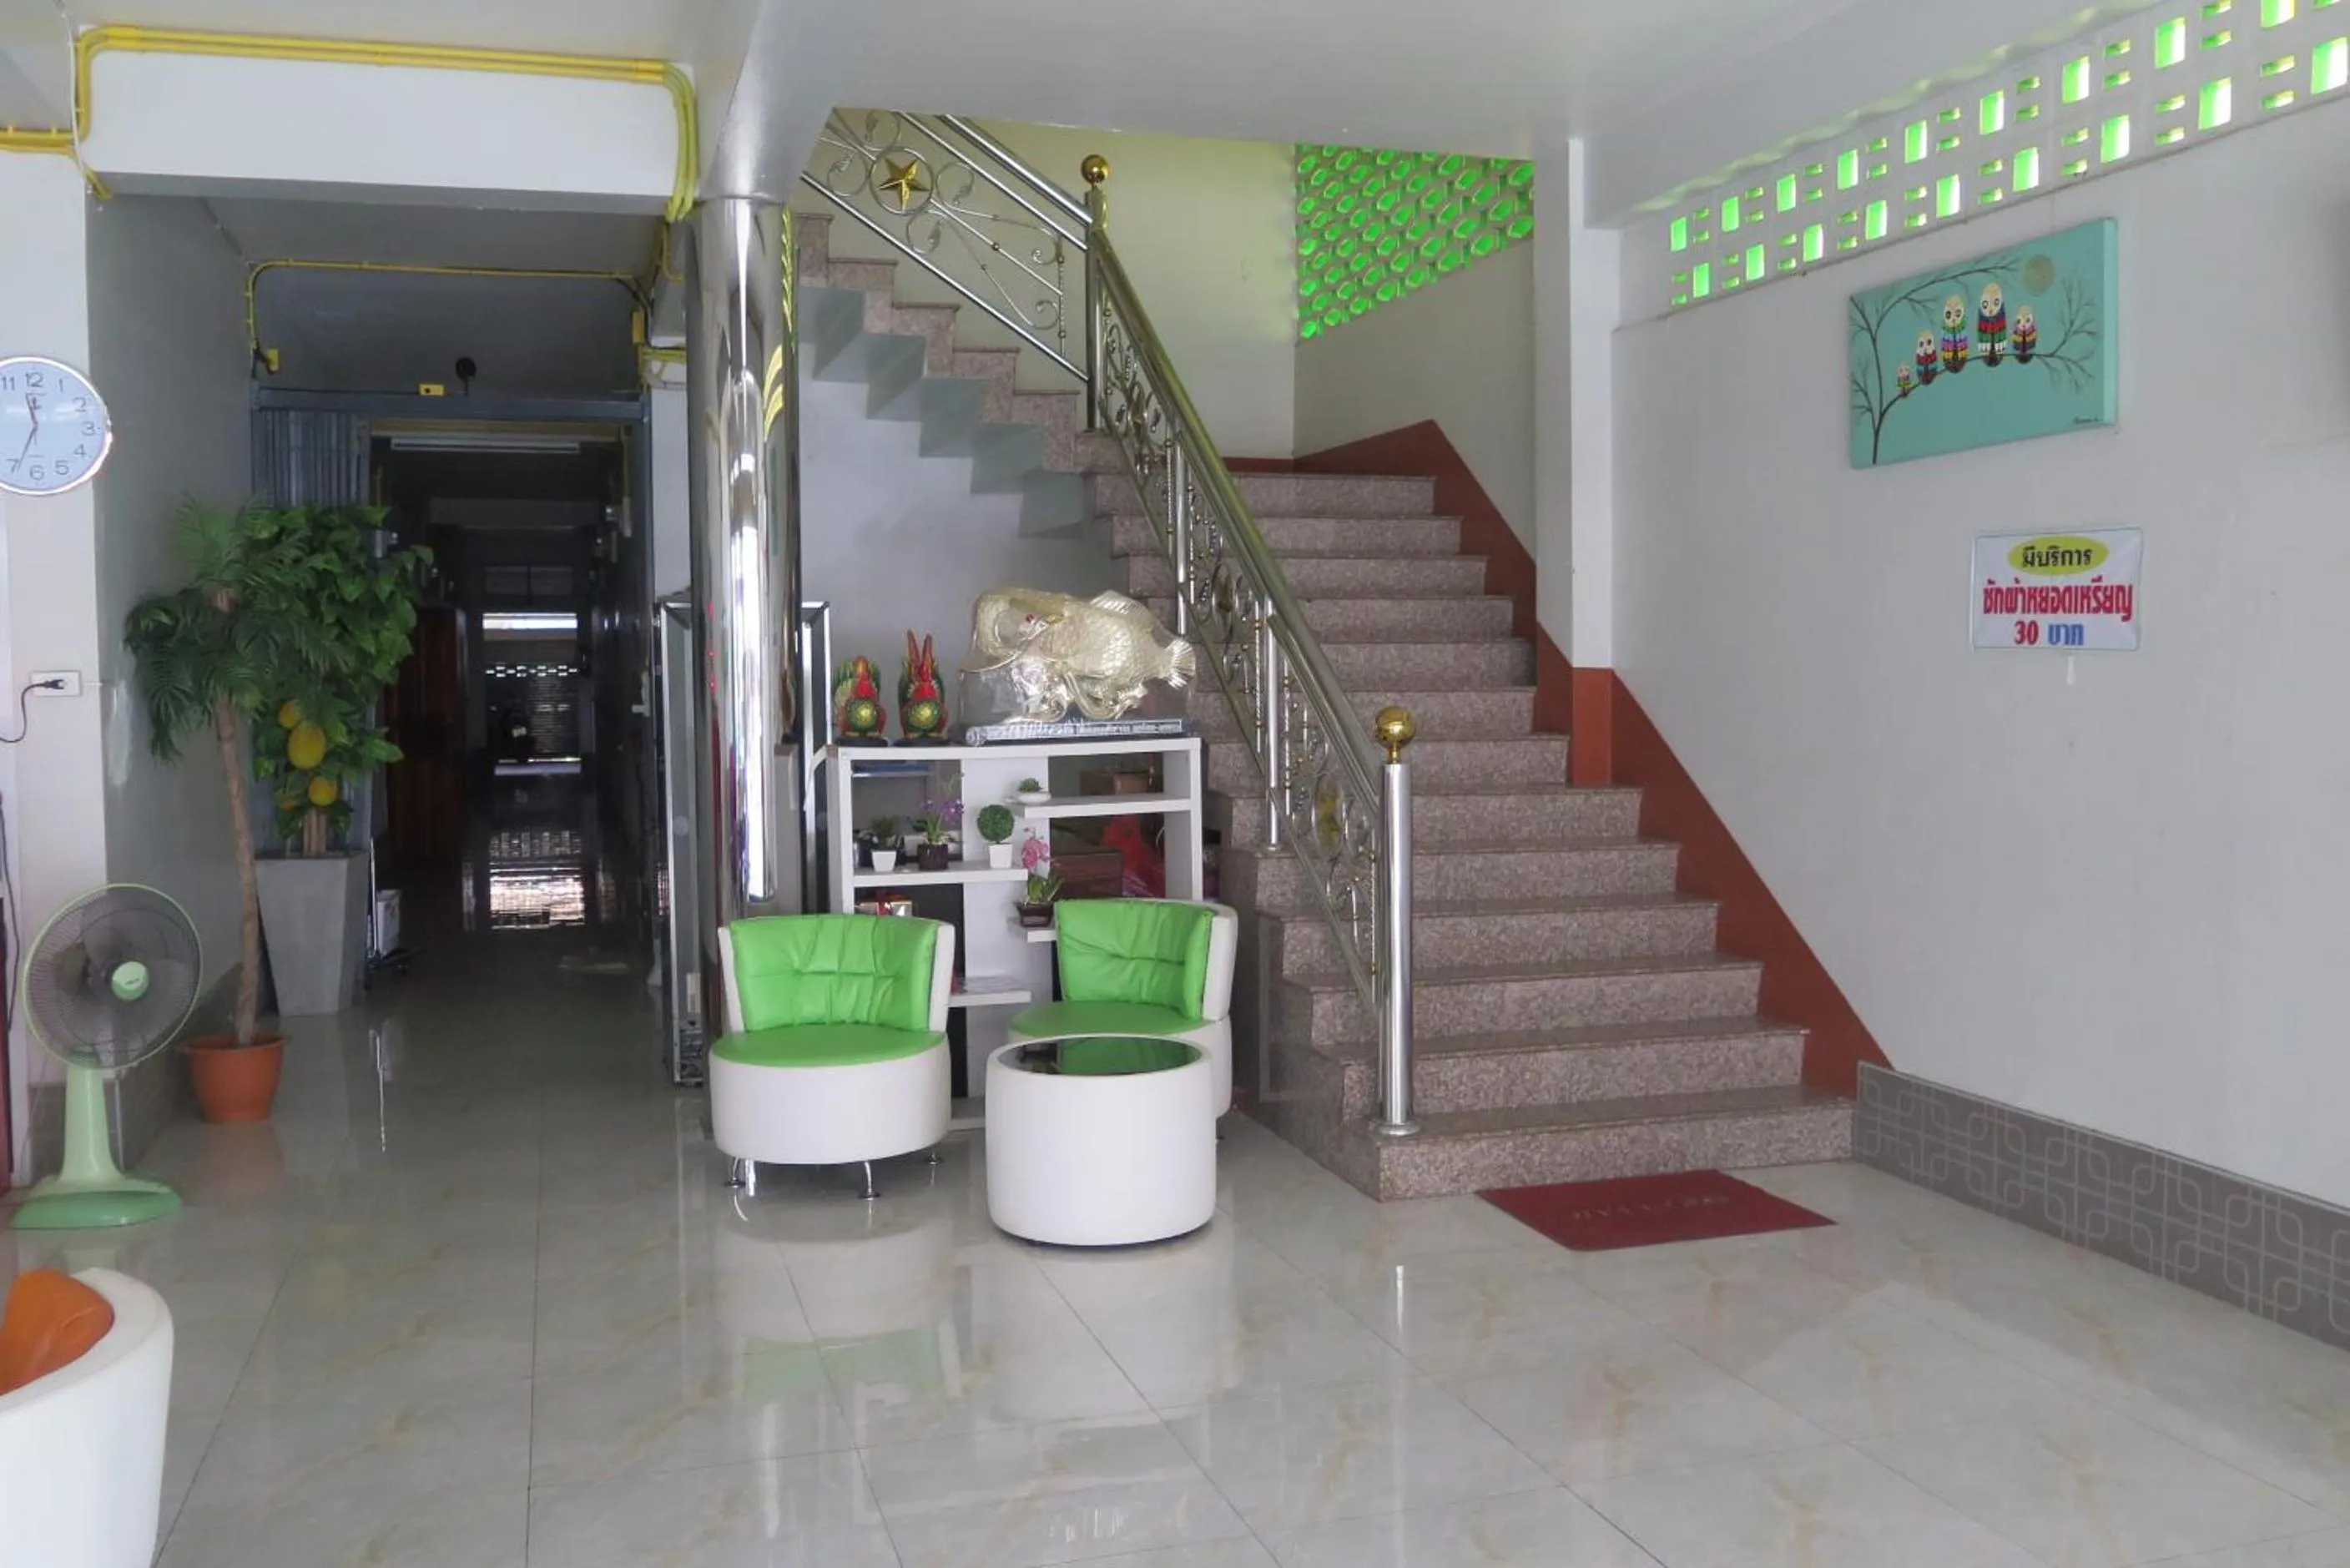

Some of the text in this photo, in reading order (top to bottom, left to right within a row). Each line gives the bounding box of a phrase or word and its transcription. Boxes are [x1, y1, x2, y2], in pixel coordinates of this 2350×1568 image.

[2, 376, 15, 391] 11
[25, 371, 43, 388] 12
[58, 378, 64, 392] 1
[73, 396, 87, 412] 2
[81, 421, 95, 436] 3
[73, 444, 87, 458] 4
[6, 458, 20, 473] 7
[29, 464, 44, 481] 6
[54, 460, 69, 476] 5
[2022, 545, 2093, 568] มีบริการ
[1983, 575, 2133, 623] ซักผ้าหยอดเหรียญ
[2014, 620, 2085, 646] 30 บาท
